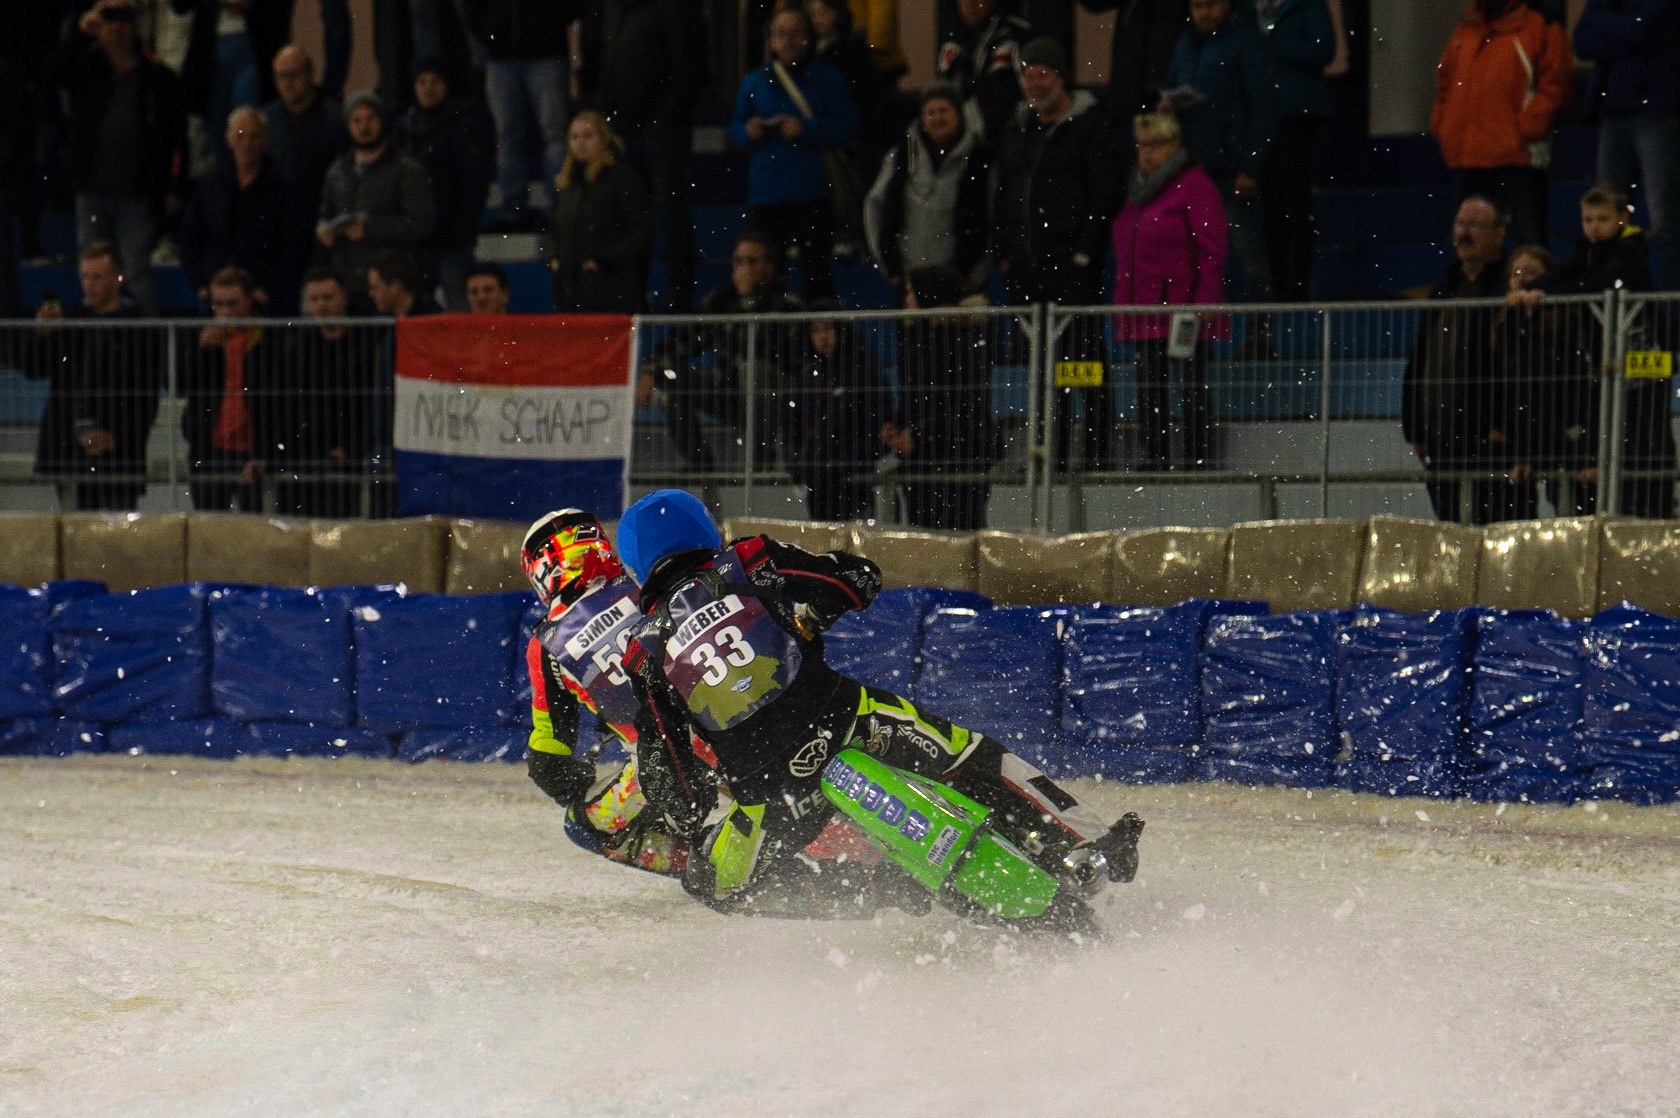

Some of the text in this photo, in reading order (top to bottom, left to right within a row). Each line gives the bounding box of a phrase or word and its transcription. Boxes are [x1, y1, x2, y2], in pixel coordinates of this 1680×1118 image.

[500, 396, 610, 445] SCHAAP
[577, 606, 624, 648] SIMON
[675, 600, 732, 647] WEBER
[690, 625, 756, 687] 33
